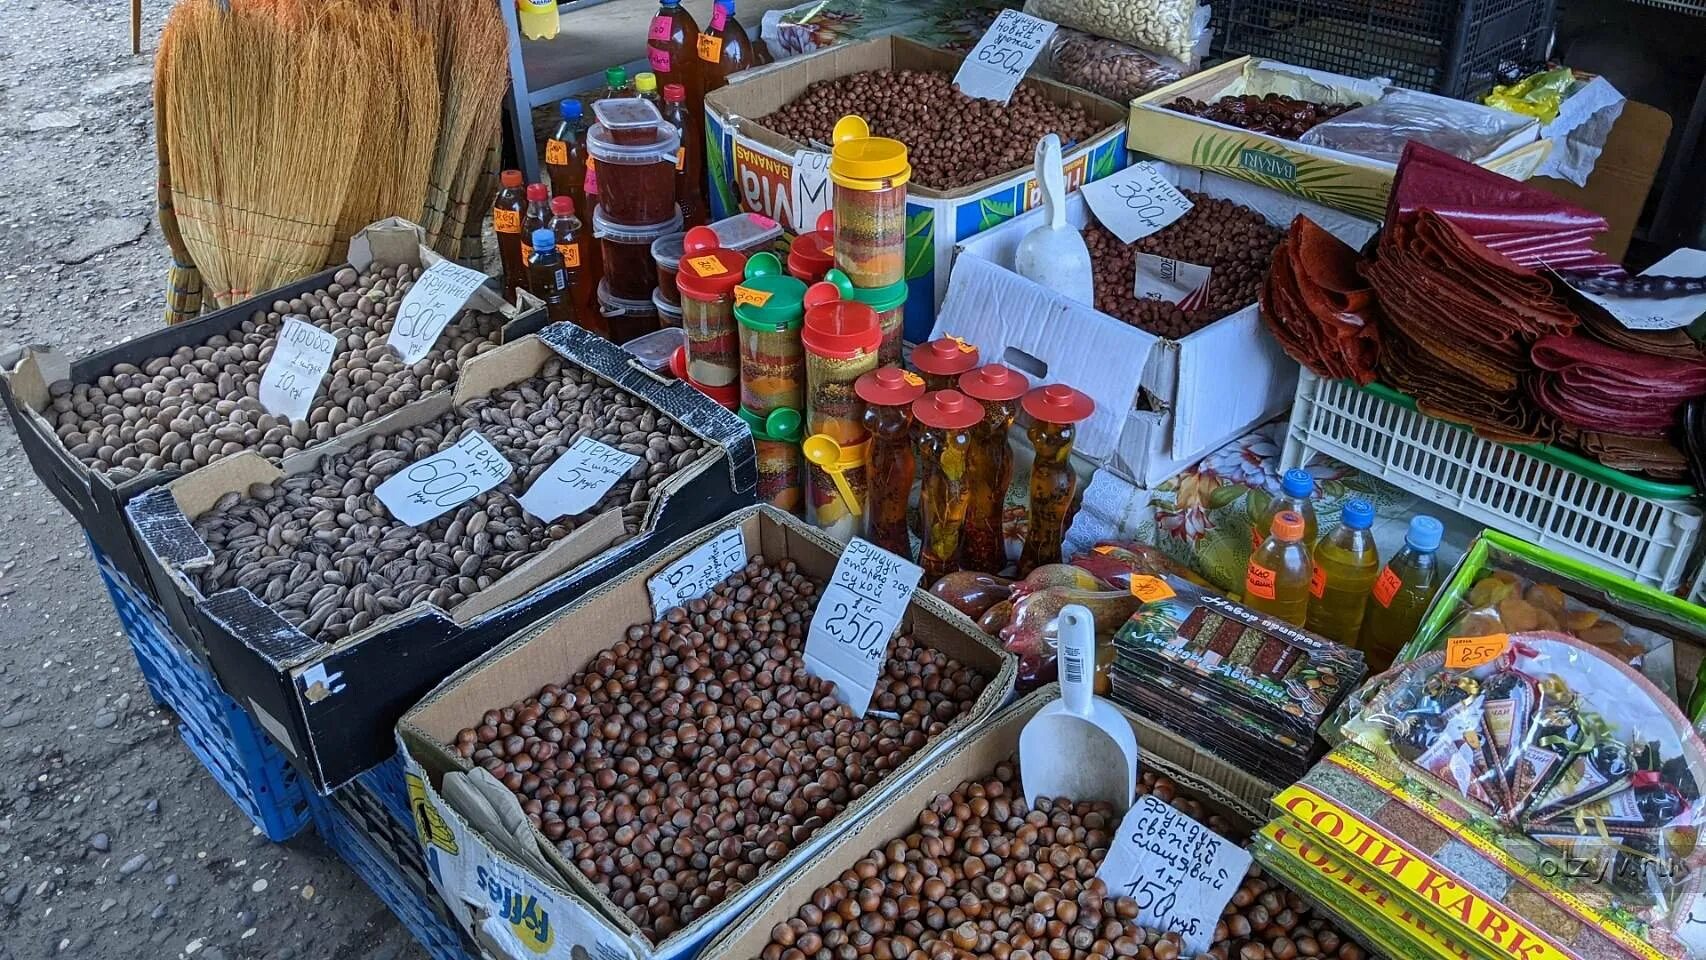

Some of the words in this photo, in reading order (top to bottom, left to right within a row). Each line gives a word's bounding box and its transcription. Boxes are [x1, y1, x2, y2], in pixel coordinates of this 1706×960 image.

[978, 44, 1023, 69] 650
[736, 146, 789, 179] BANANAS
[1244, 152, 1292, 178] BARARI
[1111, 181, 1165, 219] 300
[283, 320, 331, 354] Проба
[397, 302, 447, 341] 800
[274, 371, 296, 390] 10
[408, 459, 480, 507] 600
[558, 467, 591, 482] 5
[849, 540, 901, 575] Фундук
[826, 603, 884, 651] 250
[1201, 595, 1260, 624] Набор
[1143, 797, 1221, 854] Фундук
[1286, 796, 1416, 879] СОЛИ
[1415, 866, 1545, 960] КАВК
[477, 864, 549, 944] Fyffes
[1124, 875, 1176, 918] 150
